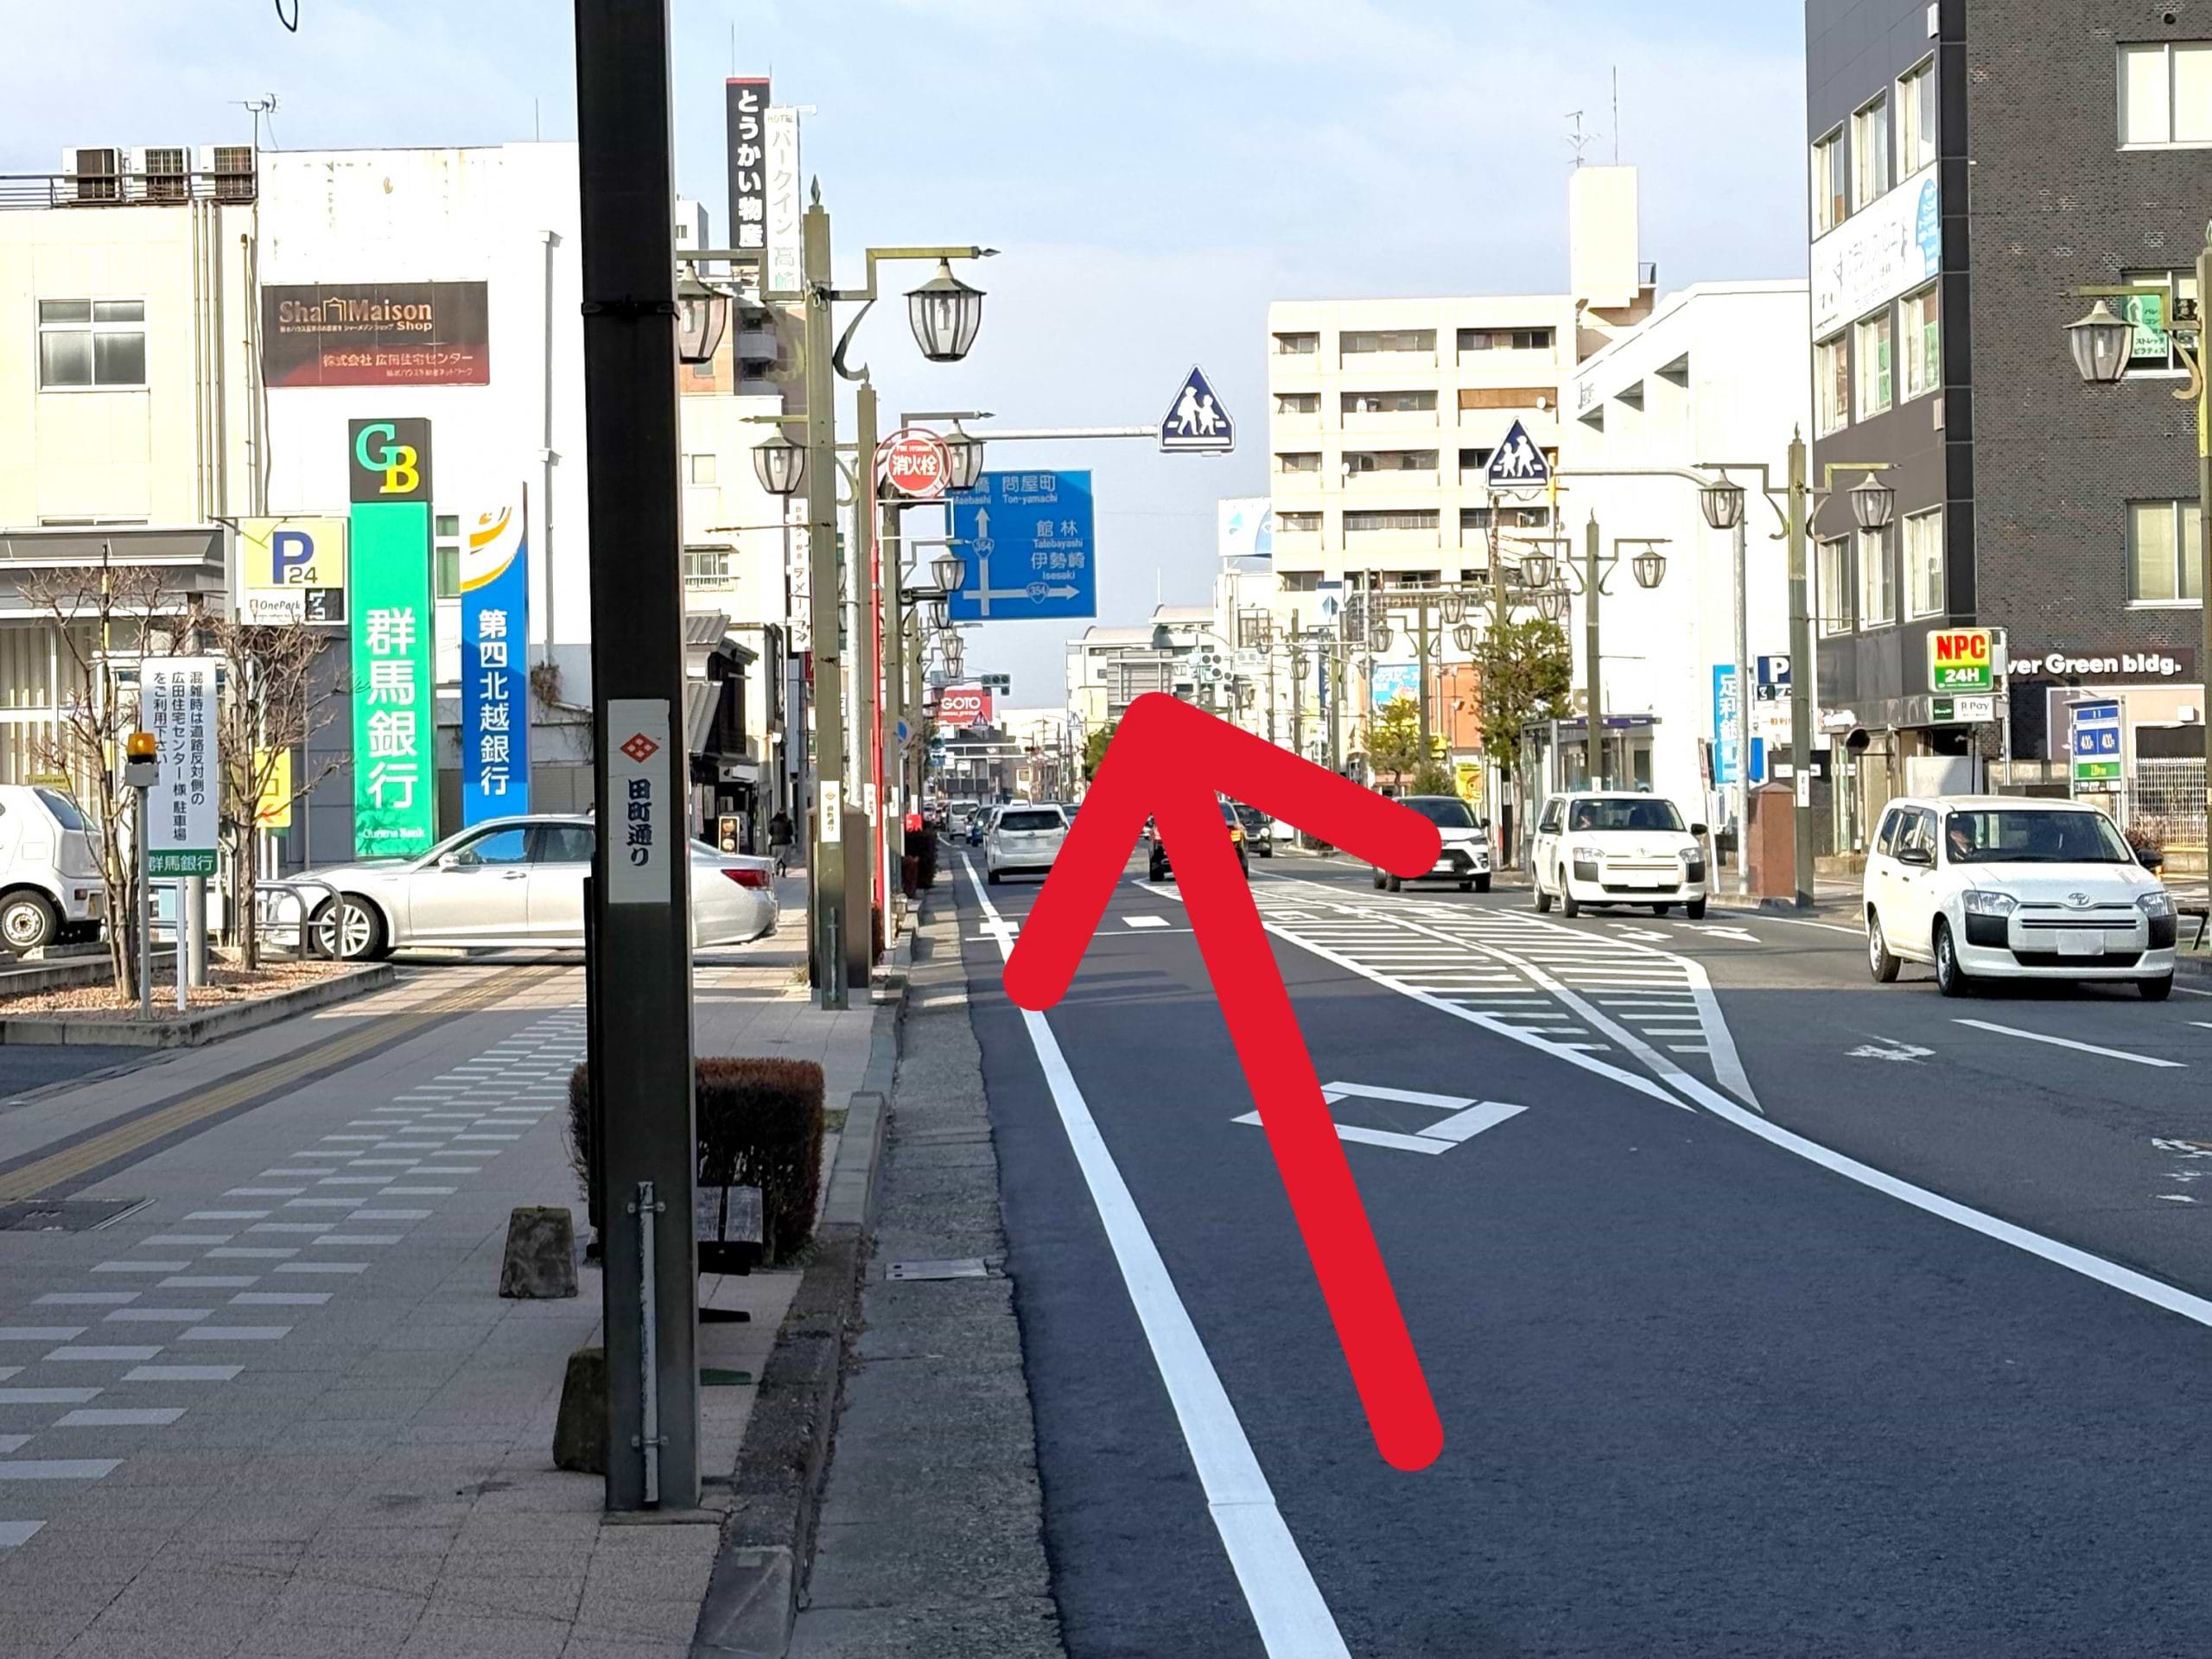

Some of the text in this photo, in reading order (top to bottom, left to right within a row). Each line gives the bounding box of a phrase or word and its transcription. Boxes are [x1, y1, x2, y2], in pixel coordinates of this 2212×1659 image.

[738, 90, 764, 248] とうかい物産
[772, 130, 792, 235] パークイン
[348, 299, 432, 322] Maison
[397, 321, 433, 333] Shop
[323, 353, 474, 366] 株式会社 広田住宅センター
[355, 423, 420, 493] GB
[893, 454, 937, 476] 消火栓
[1002, 475, 1055, 493] 問屋町
[1037, 520, 1077, 537] 館林
[976, 543, 991, 551] 354
[1033, 538, 1083, 549] Tatebayashi
[273, 531, 314, 584] P
[1031, 552, 1085, 569] 伊勢崎
[289, 567, 318, 583] 24
[1043, 570, 1075, 580] Isesaki
[1030, 585, 1046, 594] 354
[260, 601, 301, 610] OnePark
[1936, 635, 1986, 660] NPC
[1769, 658, 1789, 683] P
[2008, 653, 2182, 675] ver Green bldg.
[1945, 668, 1980, 683] 24H
[366, 607, 418, 809] 群馬銀行
[478, 609, 510, 796] 第四北越銀行
[942, 696, 981, 709] GOTO
[154, 671, 168, 765] をご利用下さい
[190, 671, 205, 805] 混雑時は道路反対側の
[626, 779, 652, 867] 田町通り
[149, 855, 213, 872] 群馬銀行
